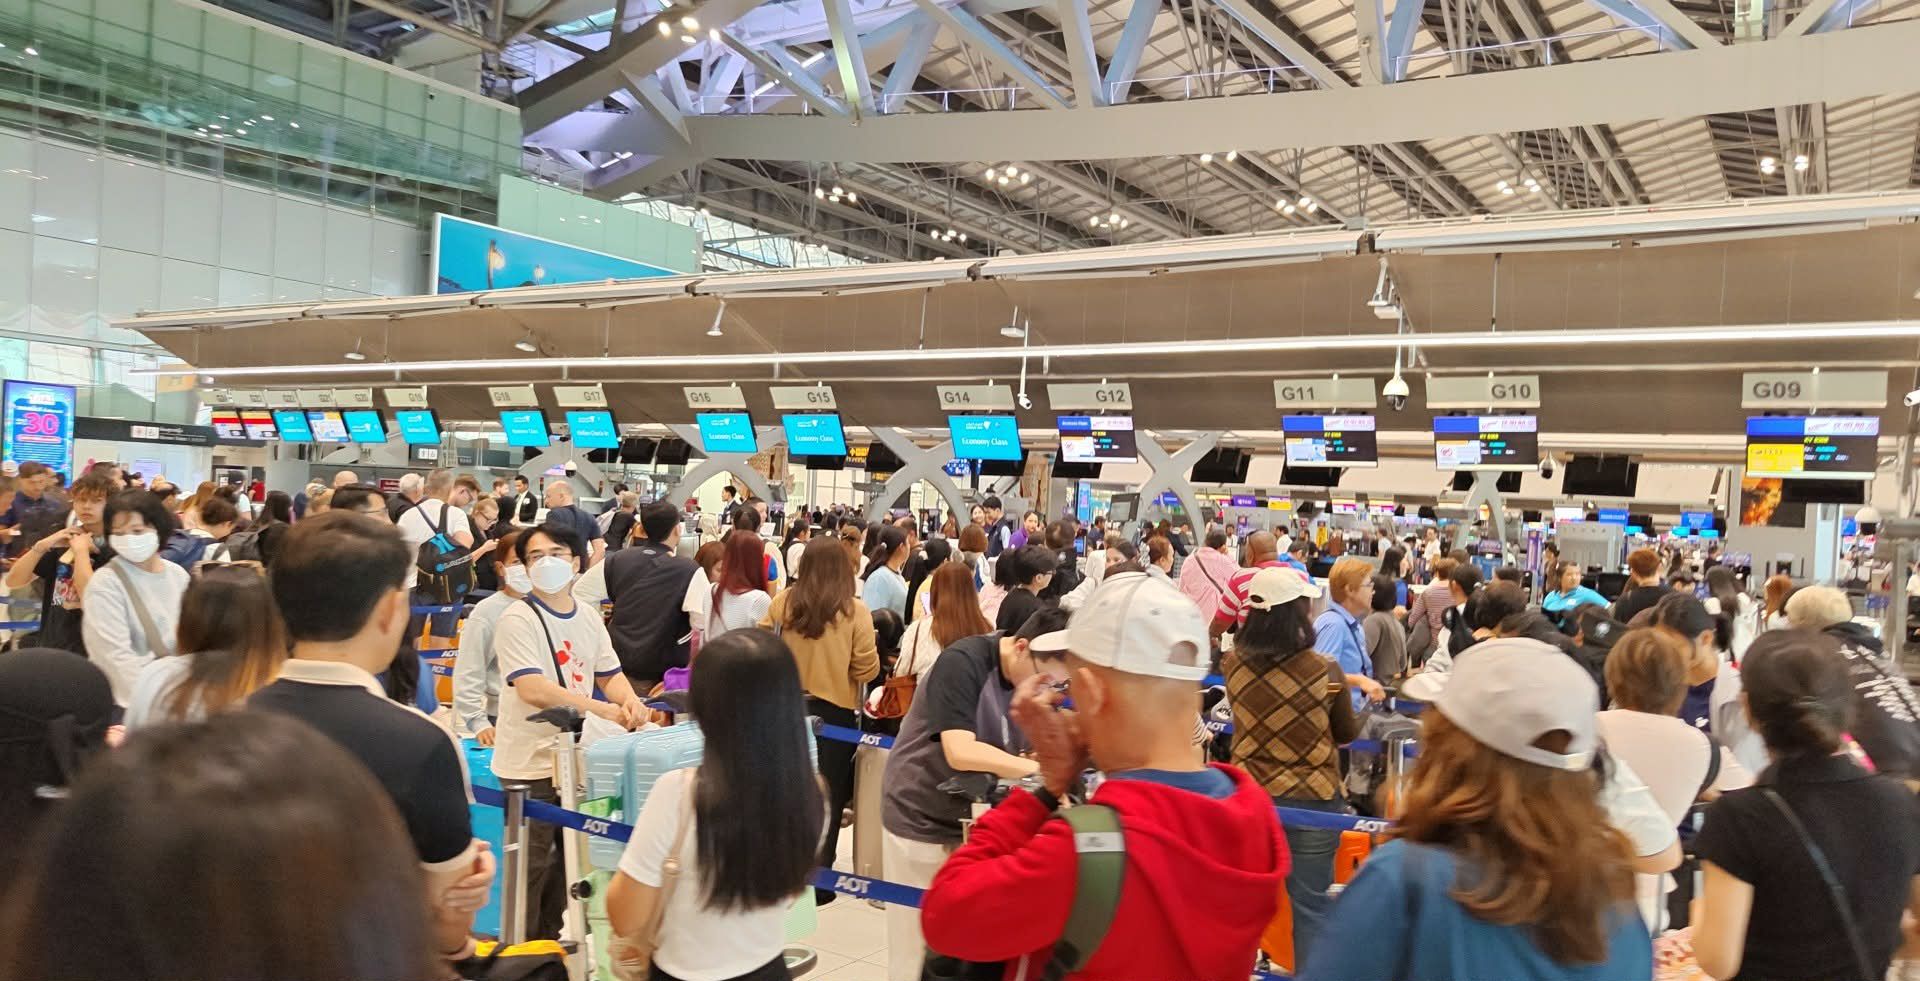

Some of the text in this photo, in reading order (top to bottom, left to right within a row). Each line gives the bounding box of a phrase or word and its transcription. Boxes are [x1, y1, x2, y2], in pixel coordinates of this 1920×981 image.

[493, 392, 511, 401] G18
[583, 391, 601, 401] G17
[1096, 390, 1126, 402] G12
[1282, 387, 1315, 400] G11
[1491, 384, 1531, 399] G10
[1753, 382, 1801, 399] G09
[690, 392, 711, 402] G16
[807, 391, 830, 403] G15
[944, 391, 970, 403] G14
[23, 412, 59, 434] 30
[708, 432, 745, 441] Economy Class
[795, 434, 819, 443] Economy
[961, 437, 1008, 447] Economy Class
[860, 733, 882, 746] AOT
[582, 818, 611, 835] AOT
[1353, 819, 1390, 832] AOT
[835, 876, 872, 893] AOT
